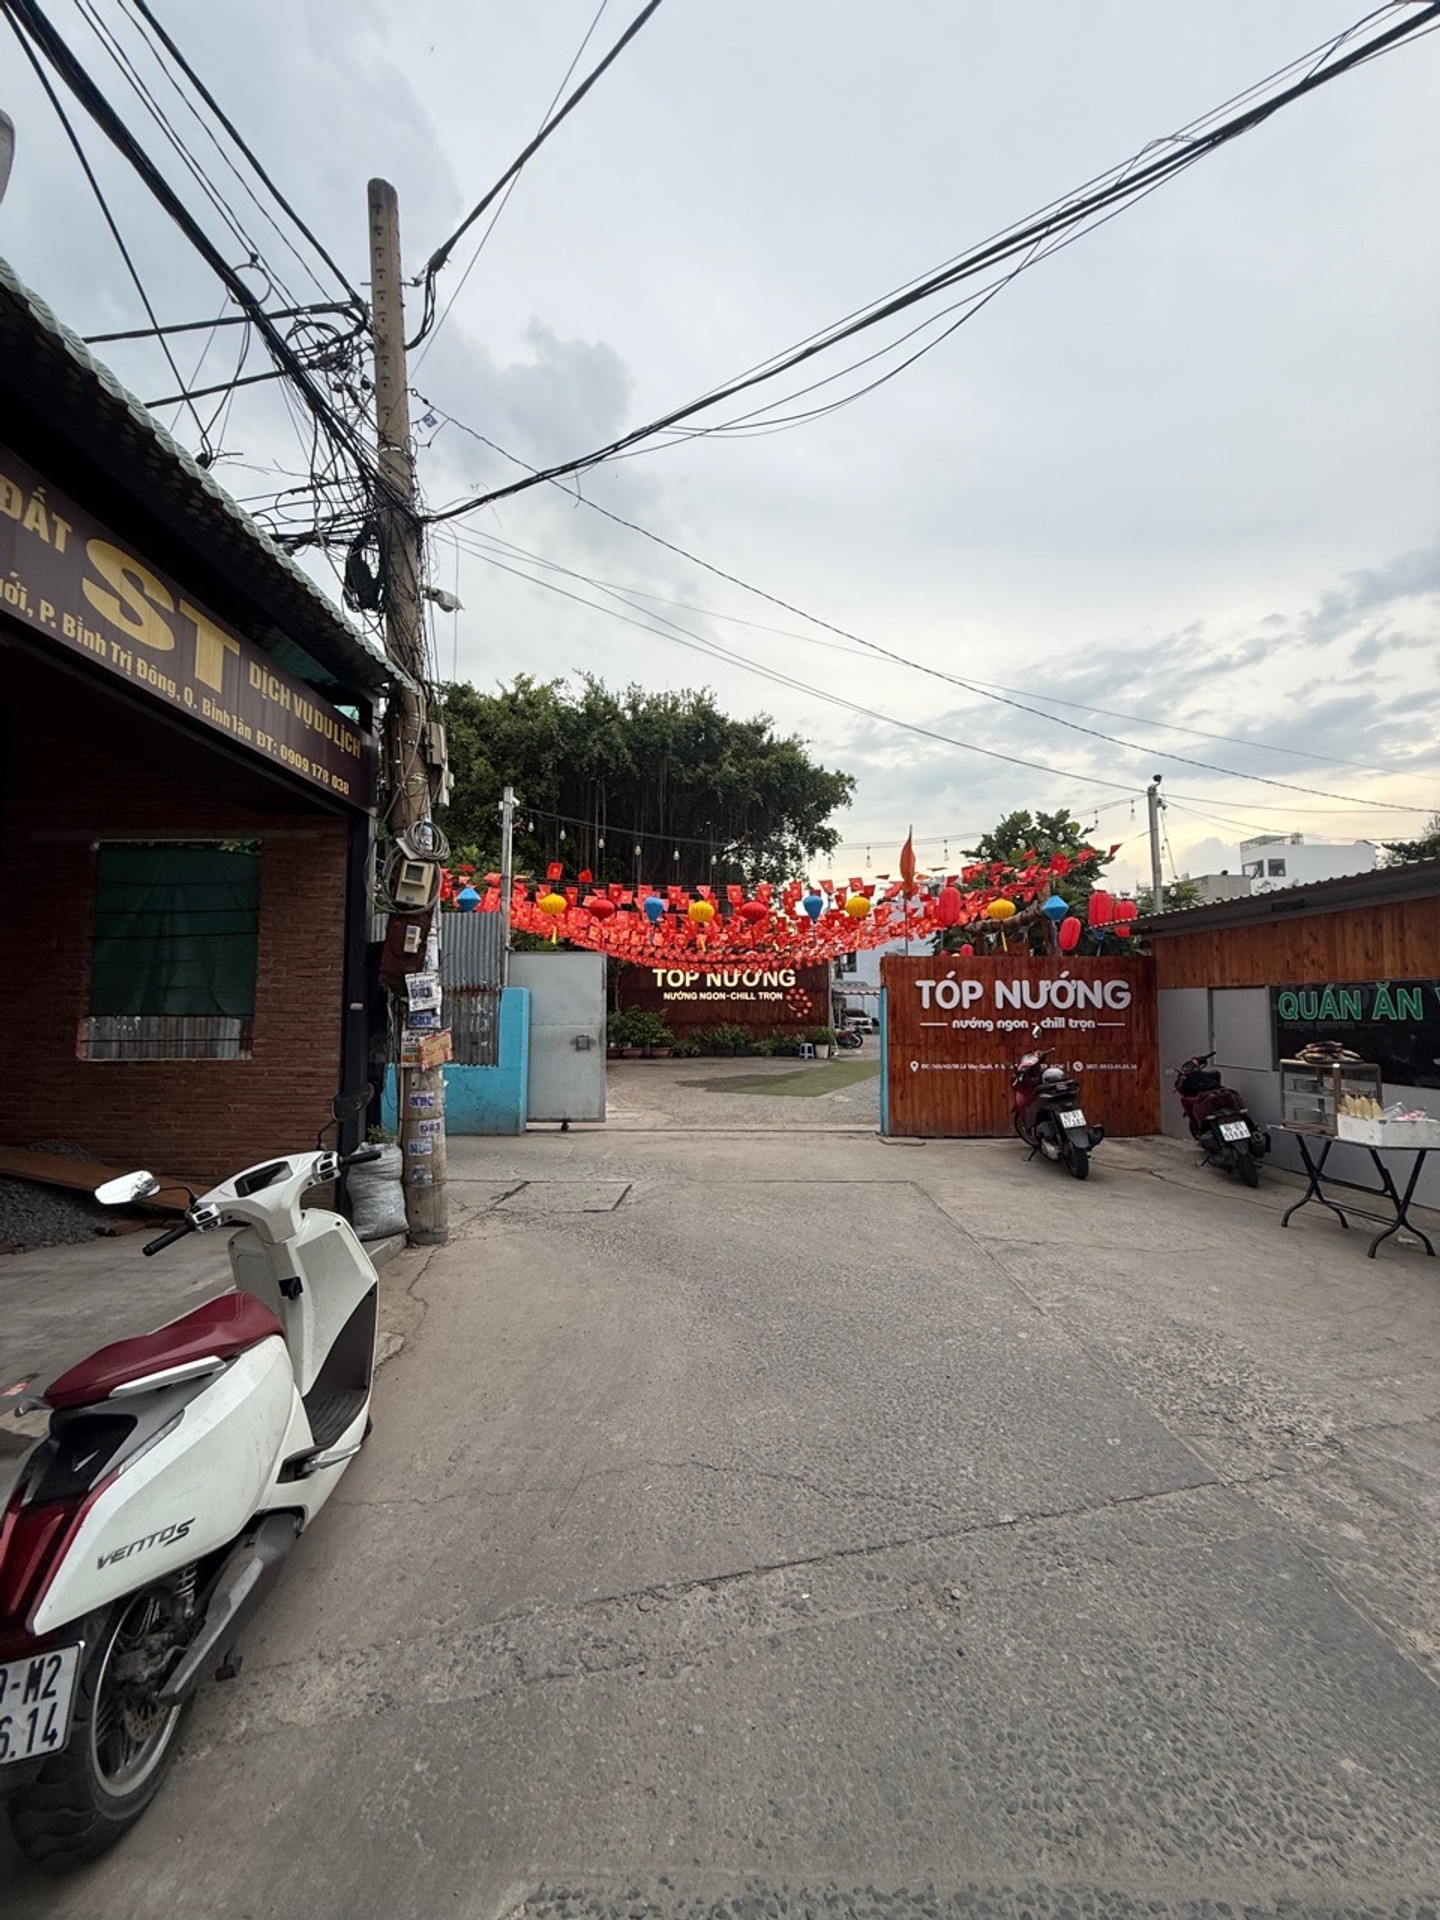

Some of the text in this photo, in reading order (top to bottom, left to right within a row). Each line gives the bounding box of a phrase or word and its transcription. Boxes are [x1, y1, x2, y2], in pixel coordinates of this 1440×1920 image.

[82, 538, 241, 694] ST
[40, 599, 56, 628] P.
[111, 641, 132, 675] Trị
[184, 687, 197, 709] Q.
[256, 730, 277, 754] ĐT:
[280, 744, 309, 772] 0909
[311, 763, 329, 783] 178
[250, 661, 291, 710] DỊCH
[294, 694, 312, 730] VỤ
[314, 711, 333, 740] DU
[915, 971, 1132, 1010] TÓP NƯỚNG
[1278, 983, 1362, 1020] QUÁN
[1372, 981, 1424, 1020] ĂN
[952, 1017, 994, 1031] nướng
[997, 1019, 1029, 1031] ngon
[1040, 1017, 1065, 1029] chill
[1068, 1018, 1095, 1031] trọn
[97, 1517, 196, 1570] VENTOS
